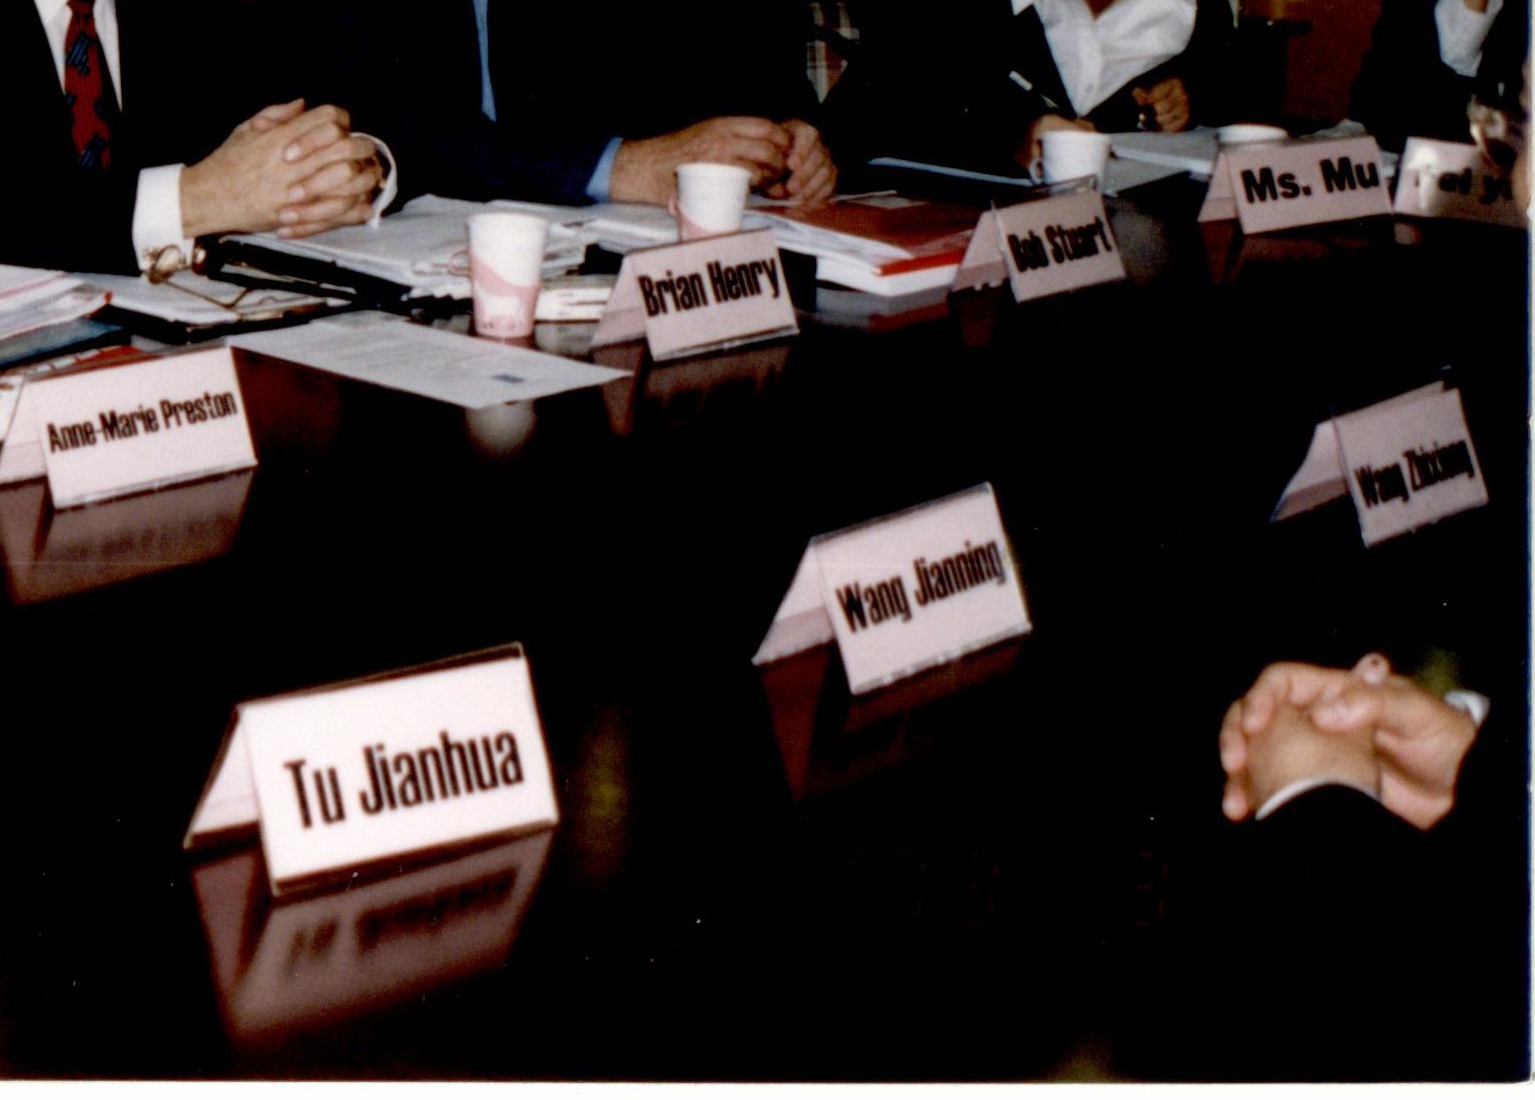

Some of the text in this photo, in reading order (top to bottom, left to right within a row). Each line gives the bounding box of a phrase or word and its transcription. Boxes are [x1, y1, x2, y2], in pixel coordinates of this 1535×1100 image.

[1240, 166, 1313, 204] Ms.
[1320, 156, 1380, 193] Mu
[1043, 215, 1113, 265] Stuart
[638, 257, 781, 318] Brian Henry
[46, 390, 238, 455] Anne-Marie Preston
[835, 540, 1007, 634] Wang Jianning
[283, 729, 525, 830] Tu Jianhua
